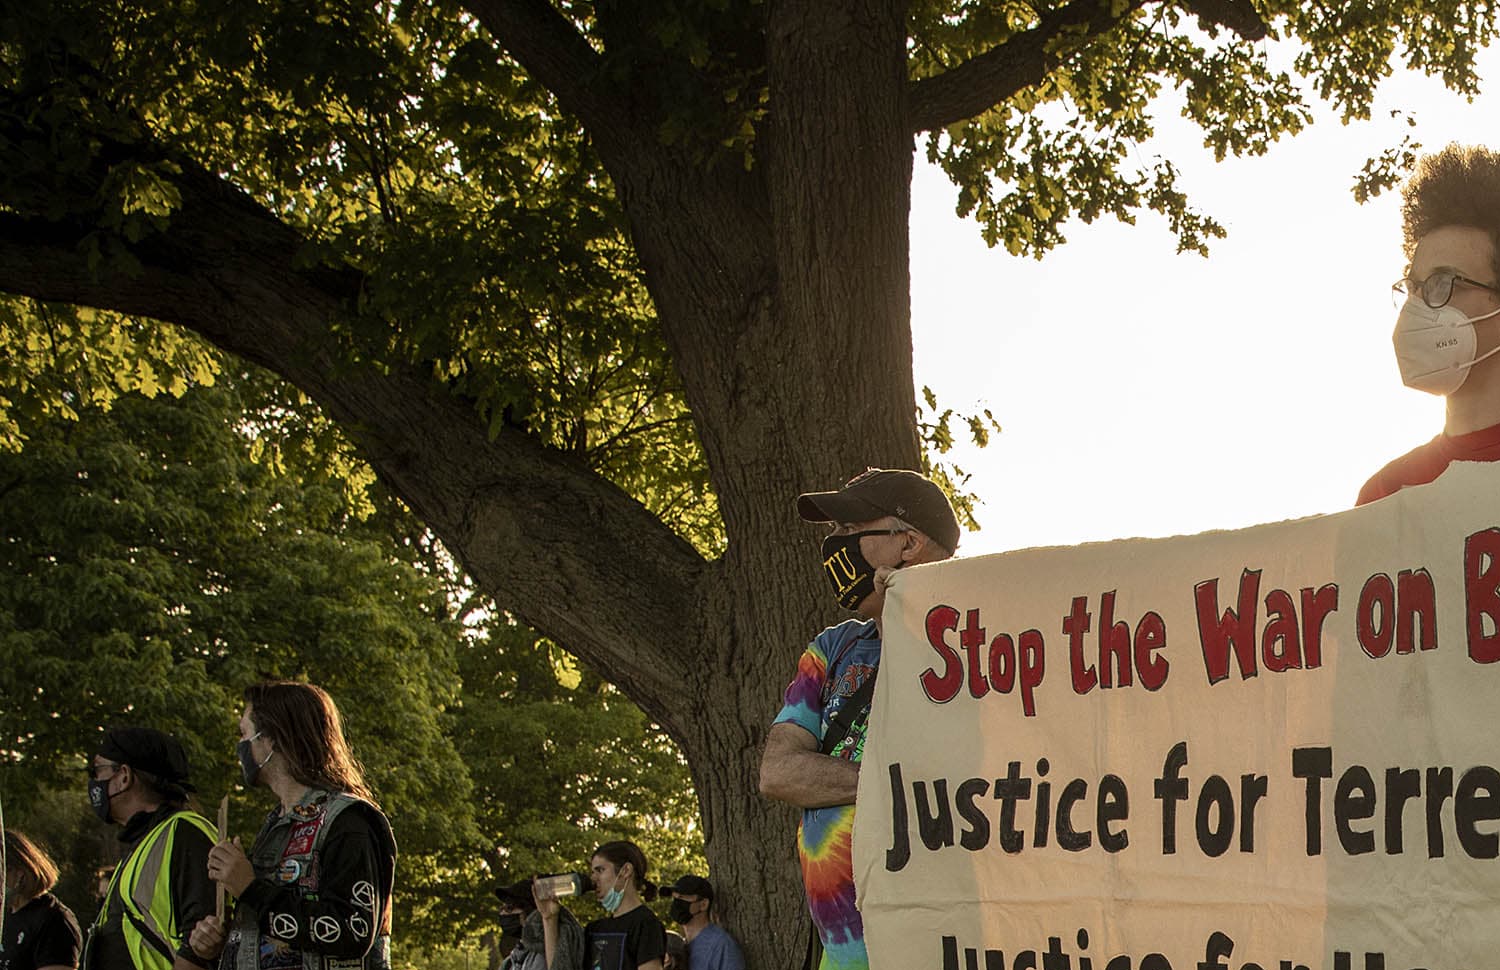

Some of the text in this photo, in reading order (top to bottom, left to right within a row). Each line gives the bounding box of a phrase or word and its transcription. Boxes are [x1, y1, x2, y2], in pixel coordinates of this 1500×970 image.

[920, 604, 1045, 717] Stop
[1062, 590, 1169, 694] the
[1195, 568, 1339, 686] War
[1356, 567, 1438, 659] on
[885, 757, 1129, 872] Justice
[1154, 741, 1268, 858] for
